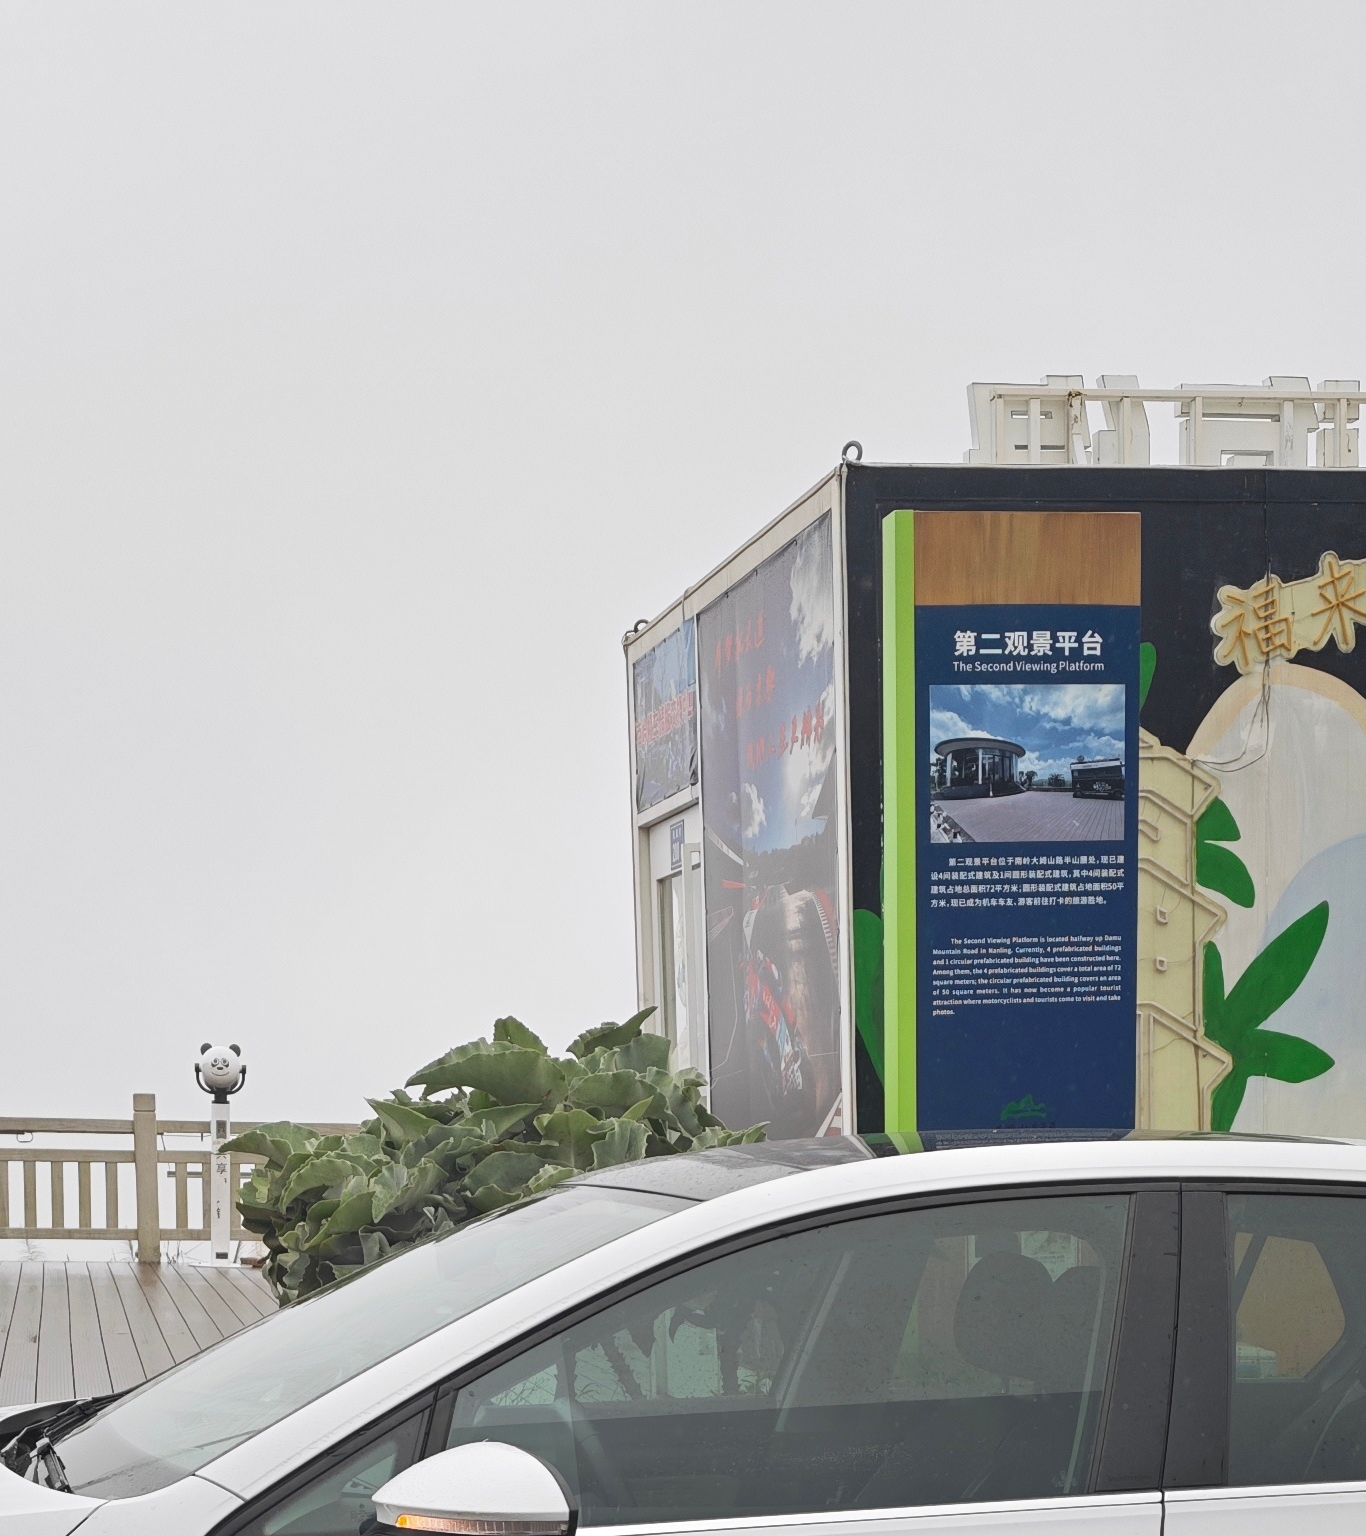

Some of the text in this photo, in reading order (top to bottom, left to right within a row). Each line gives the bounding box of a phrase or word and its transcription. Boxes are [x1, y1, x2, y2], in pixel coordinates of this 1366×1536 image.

[953, 630, 1103, 656] 第二观景平台
[953, 661, 1105, 674] The Second Viewing Platform
